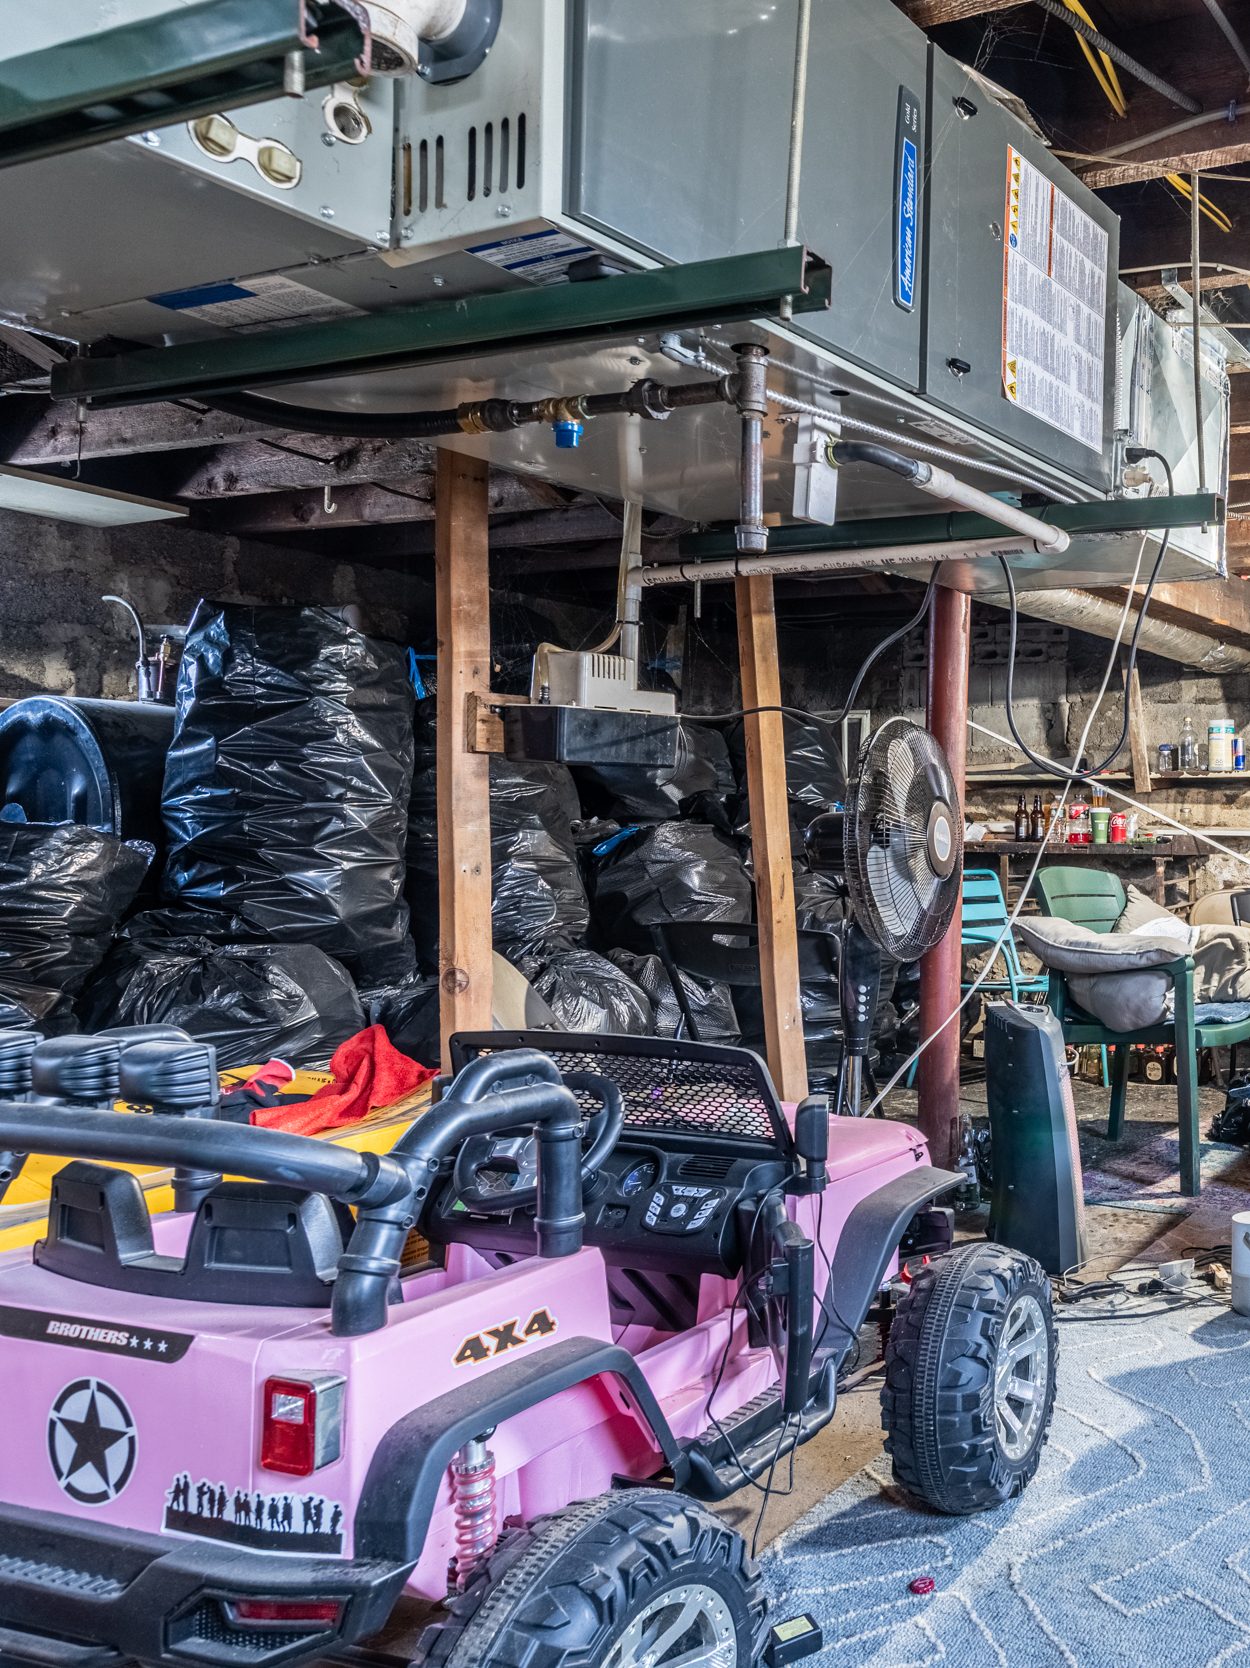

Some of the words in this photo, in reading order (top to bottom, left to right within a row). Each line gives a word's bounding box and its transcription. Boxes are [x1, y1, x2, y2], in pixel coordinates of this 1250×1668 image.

[903, 156, 915, 226] Standard
[500, 237, 524, 246] NOTICE
[900, 227, 914, 296] American
[45, 1320, 130, 1346] BROTHERS
[453, 1308, 557, 1366] 4X4
